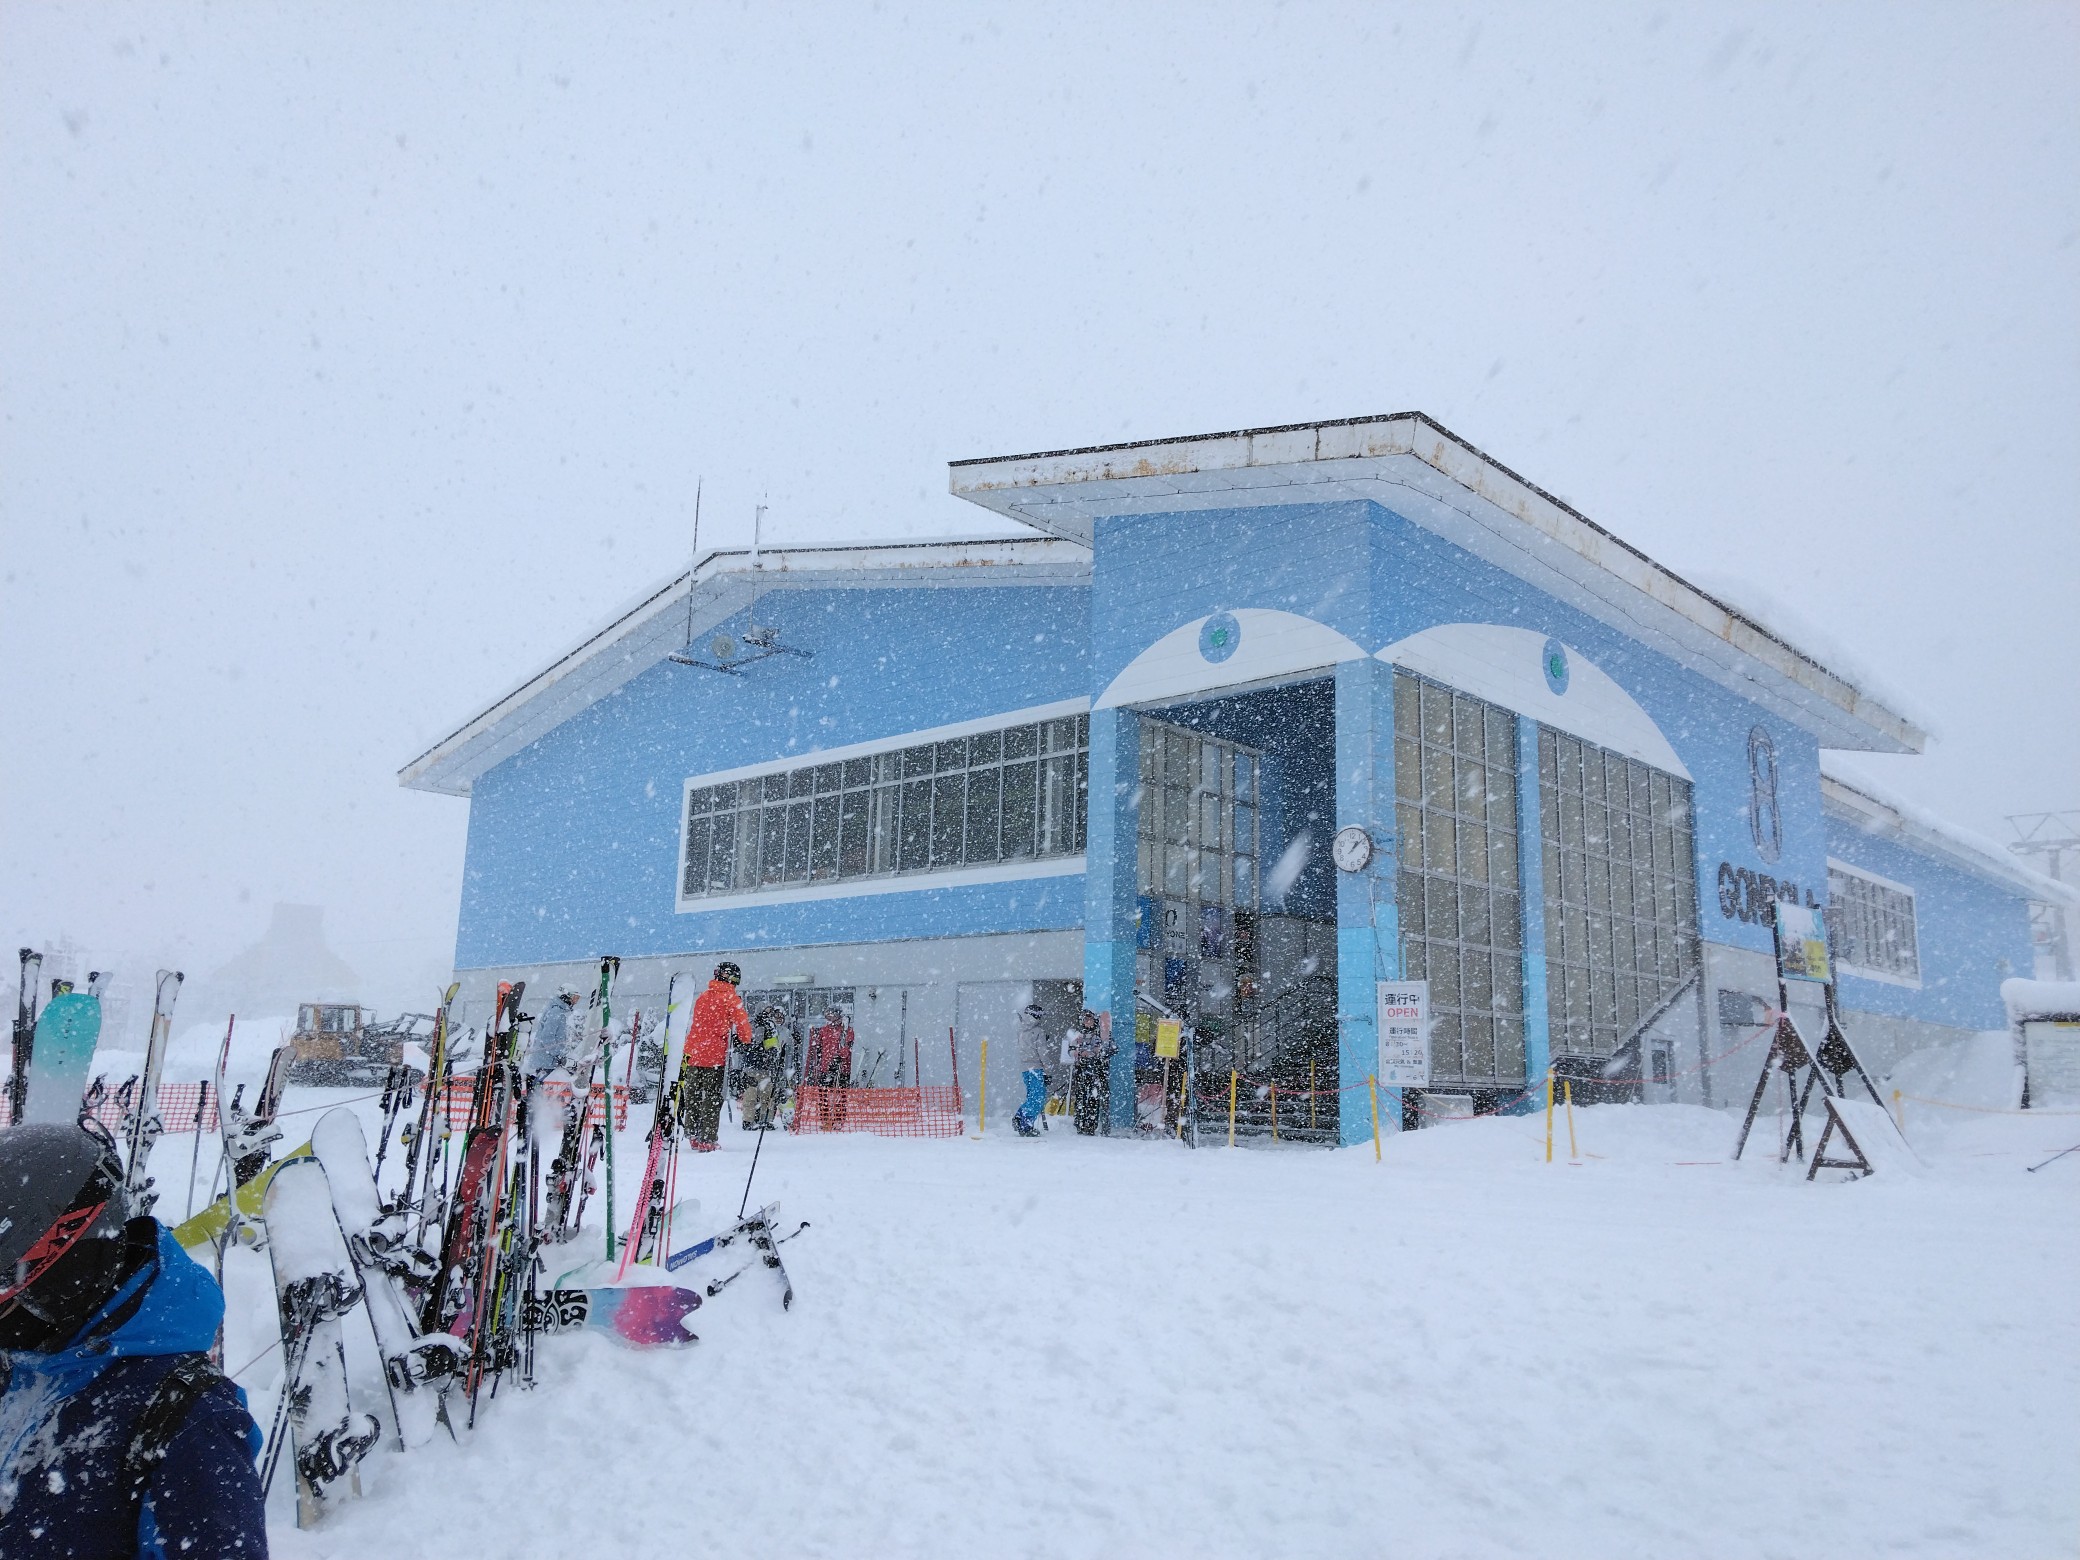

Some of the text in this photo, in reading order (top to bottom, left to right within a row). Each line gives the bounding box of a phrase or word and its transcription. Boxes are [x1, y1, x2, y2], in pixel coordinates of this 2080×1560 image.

[1385, 993, 1420, 1005] 運行中
[1387, 1007, 1418, 1017] OPEN
